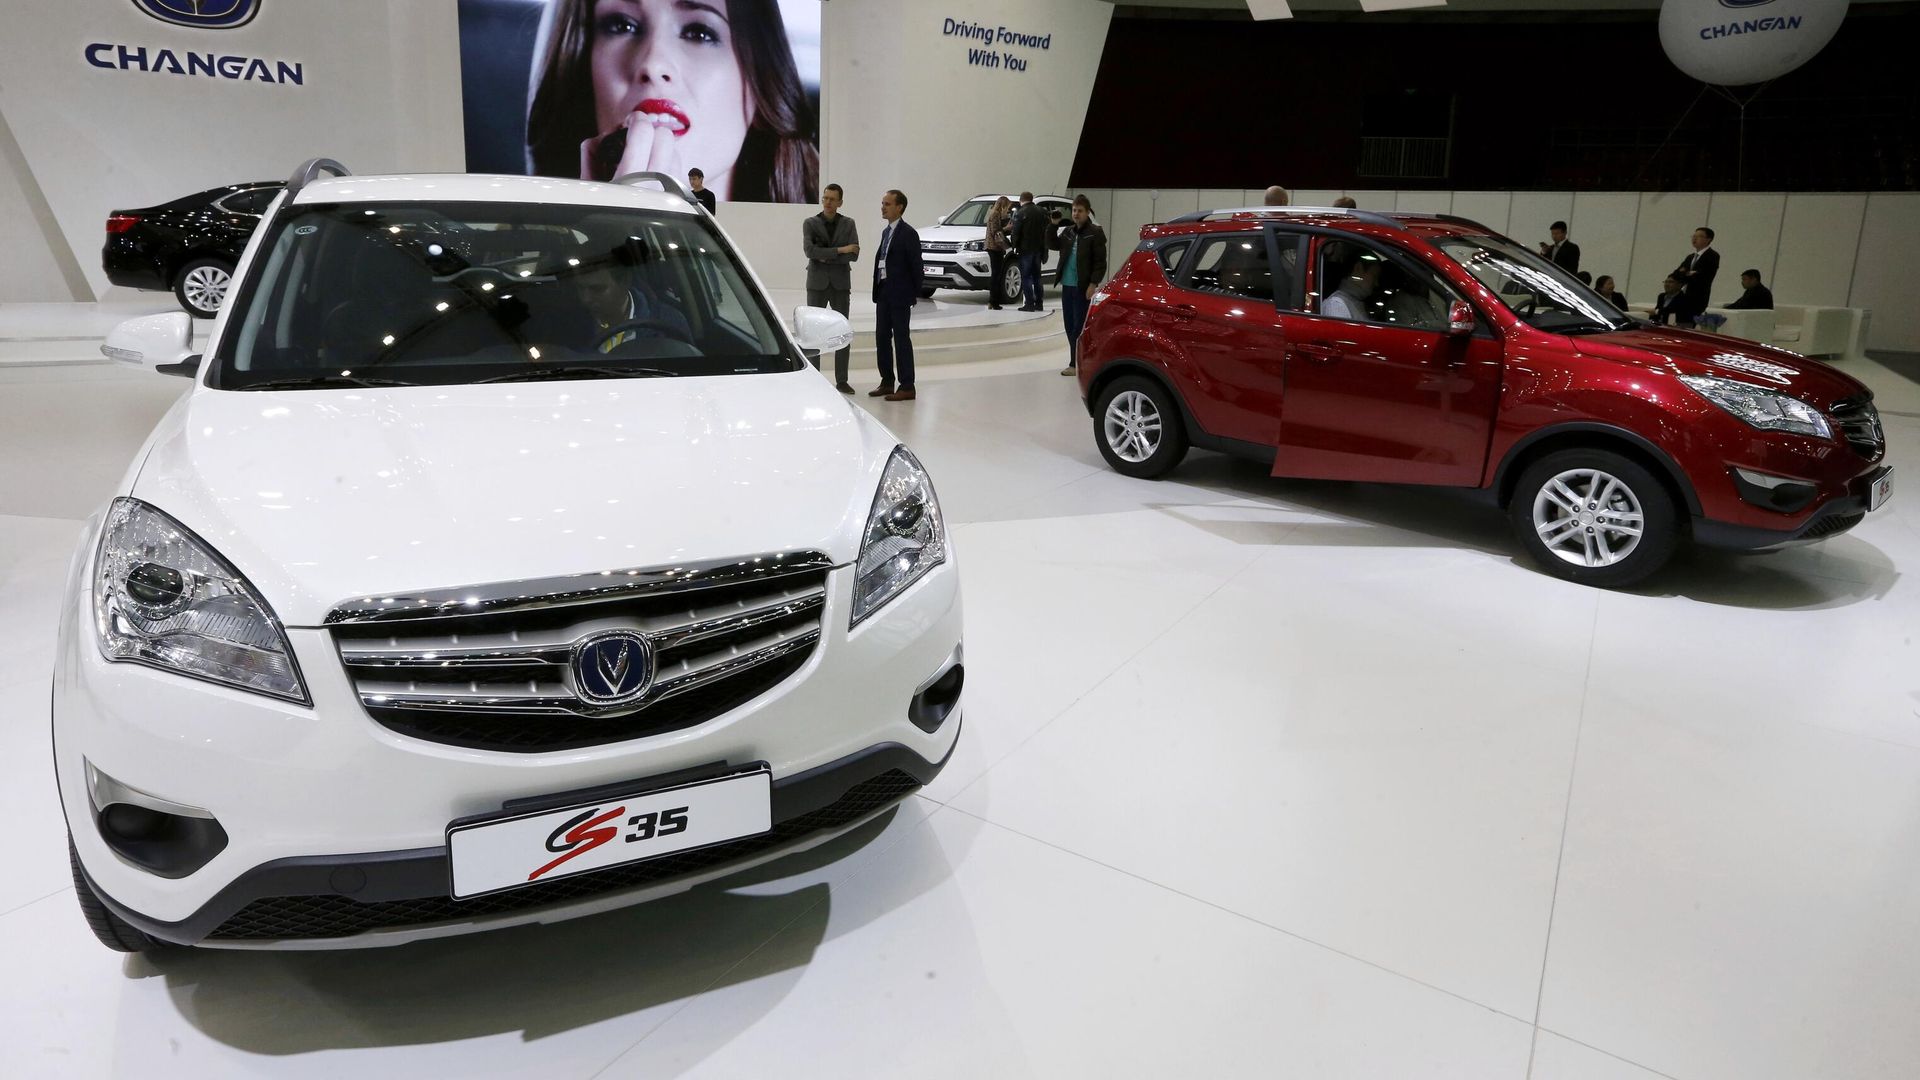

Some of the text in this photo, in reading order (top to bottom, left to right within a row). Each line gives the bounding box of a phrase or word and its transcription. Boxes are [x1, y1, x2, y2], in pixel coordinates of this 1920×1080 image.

[943, 18, 1051, 49] Driving Forward
[1700, 16, 1802, 40] CHANGAN
[84, 43, 303, 85] CHANGAN
[968, 48, 1027, 71] With You
[625, 806, 689, 843] 35
